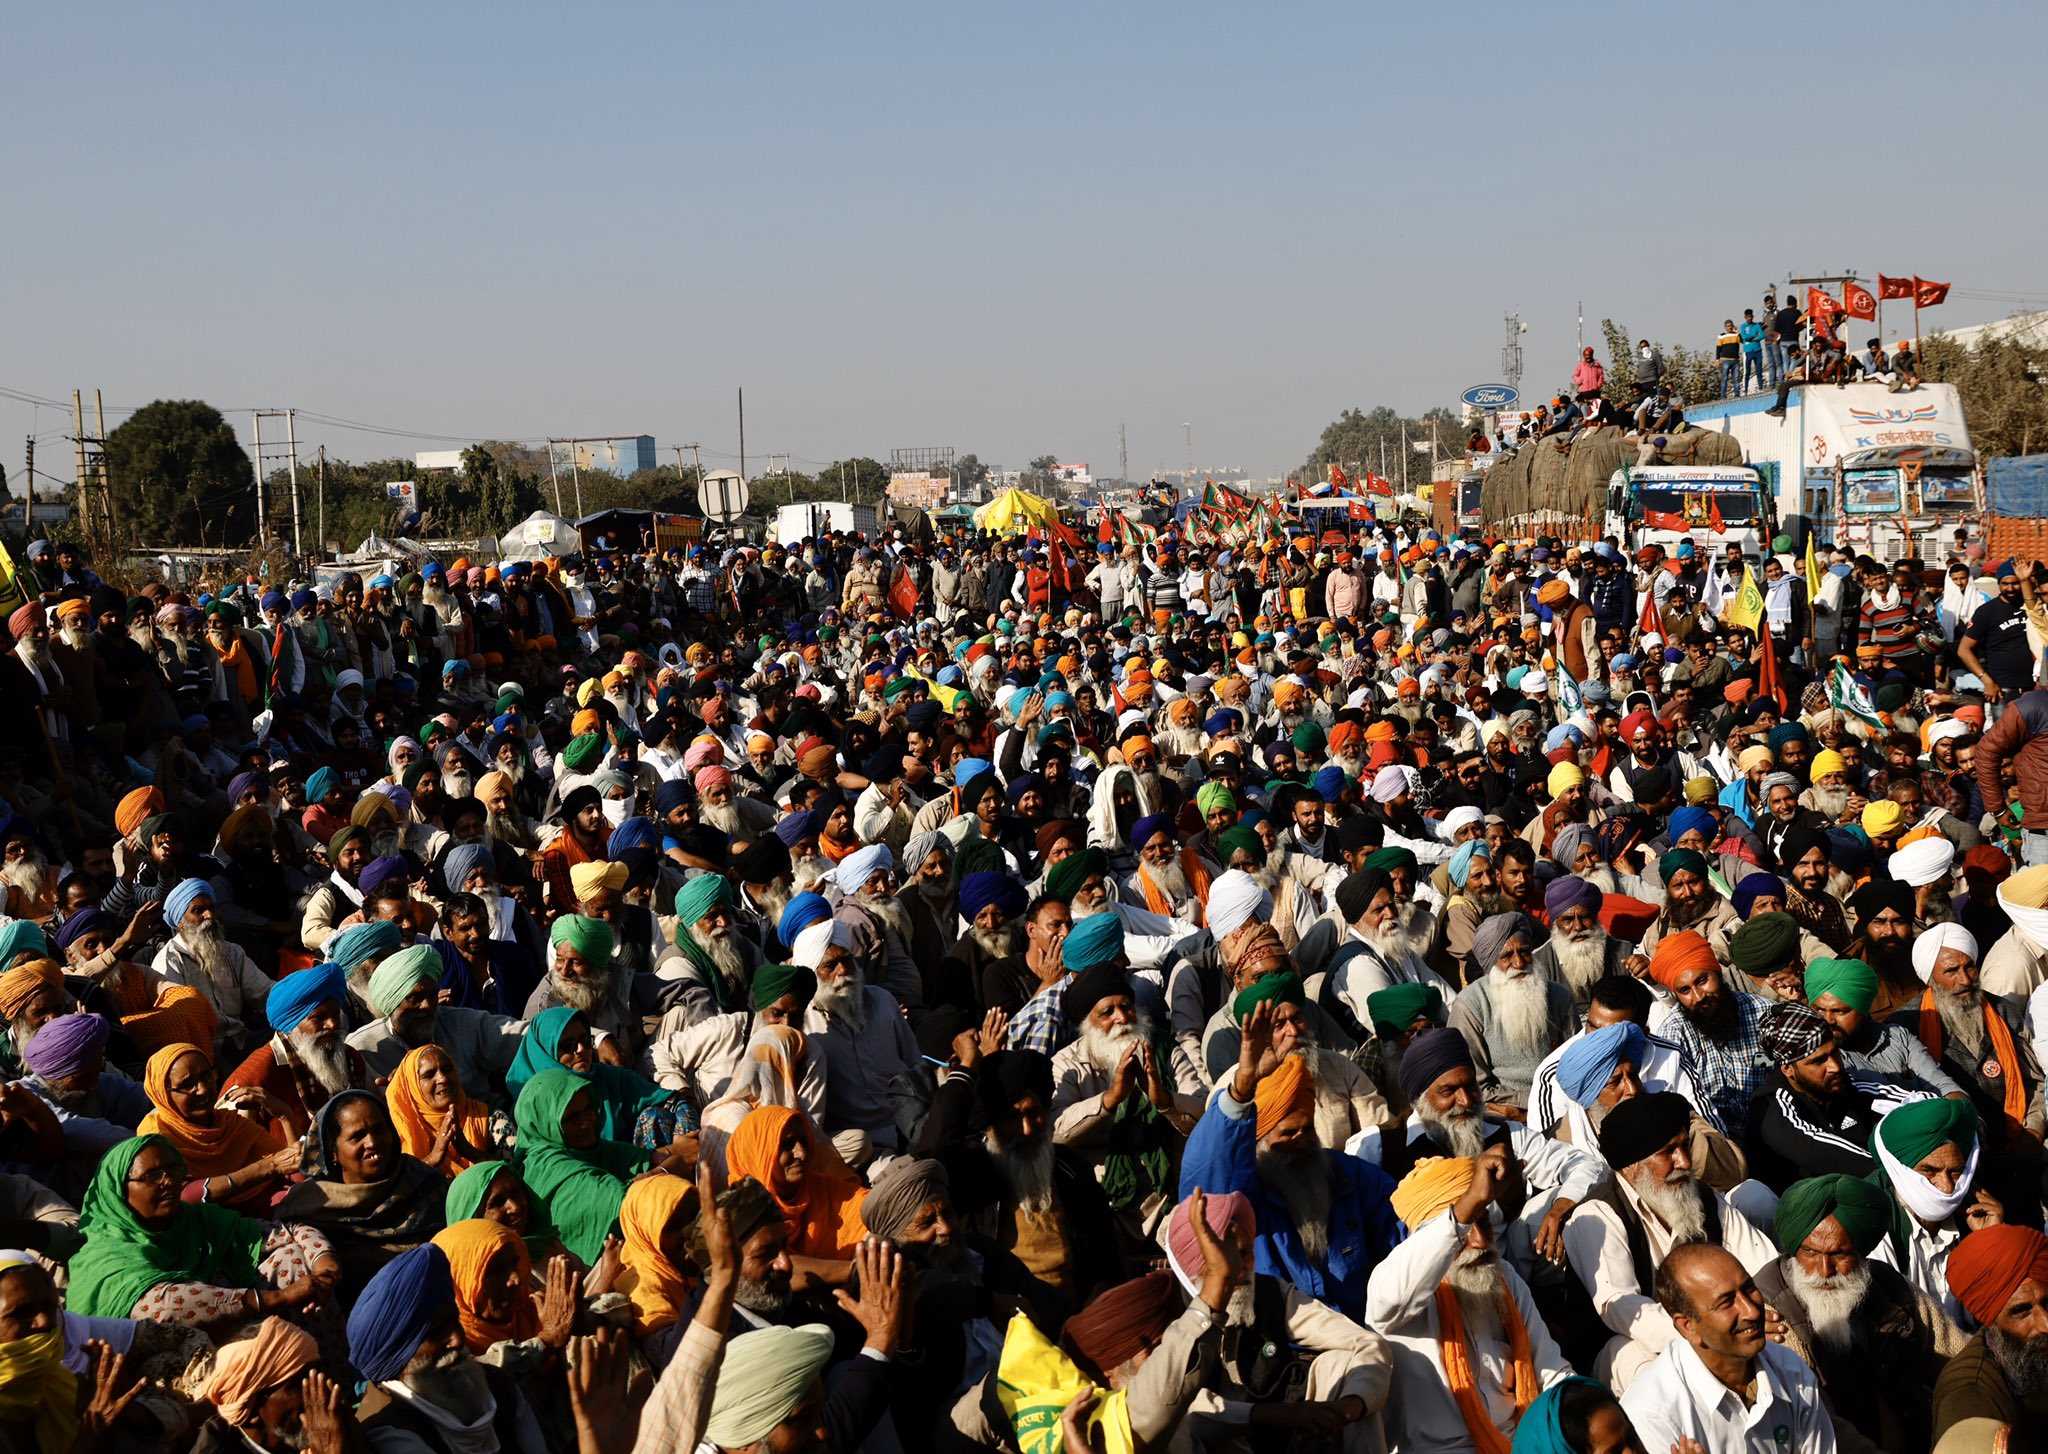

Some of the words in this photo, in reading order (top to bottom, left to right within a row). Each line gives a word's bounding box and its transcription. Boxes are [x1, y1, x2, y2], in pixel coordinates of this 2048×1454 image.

[1475, 389, 1505, 402] Ford
[1656, 473, 1676, 481] India
[1713, 473, 1745, 481] Permit
